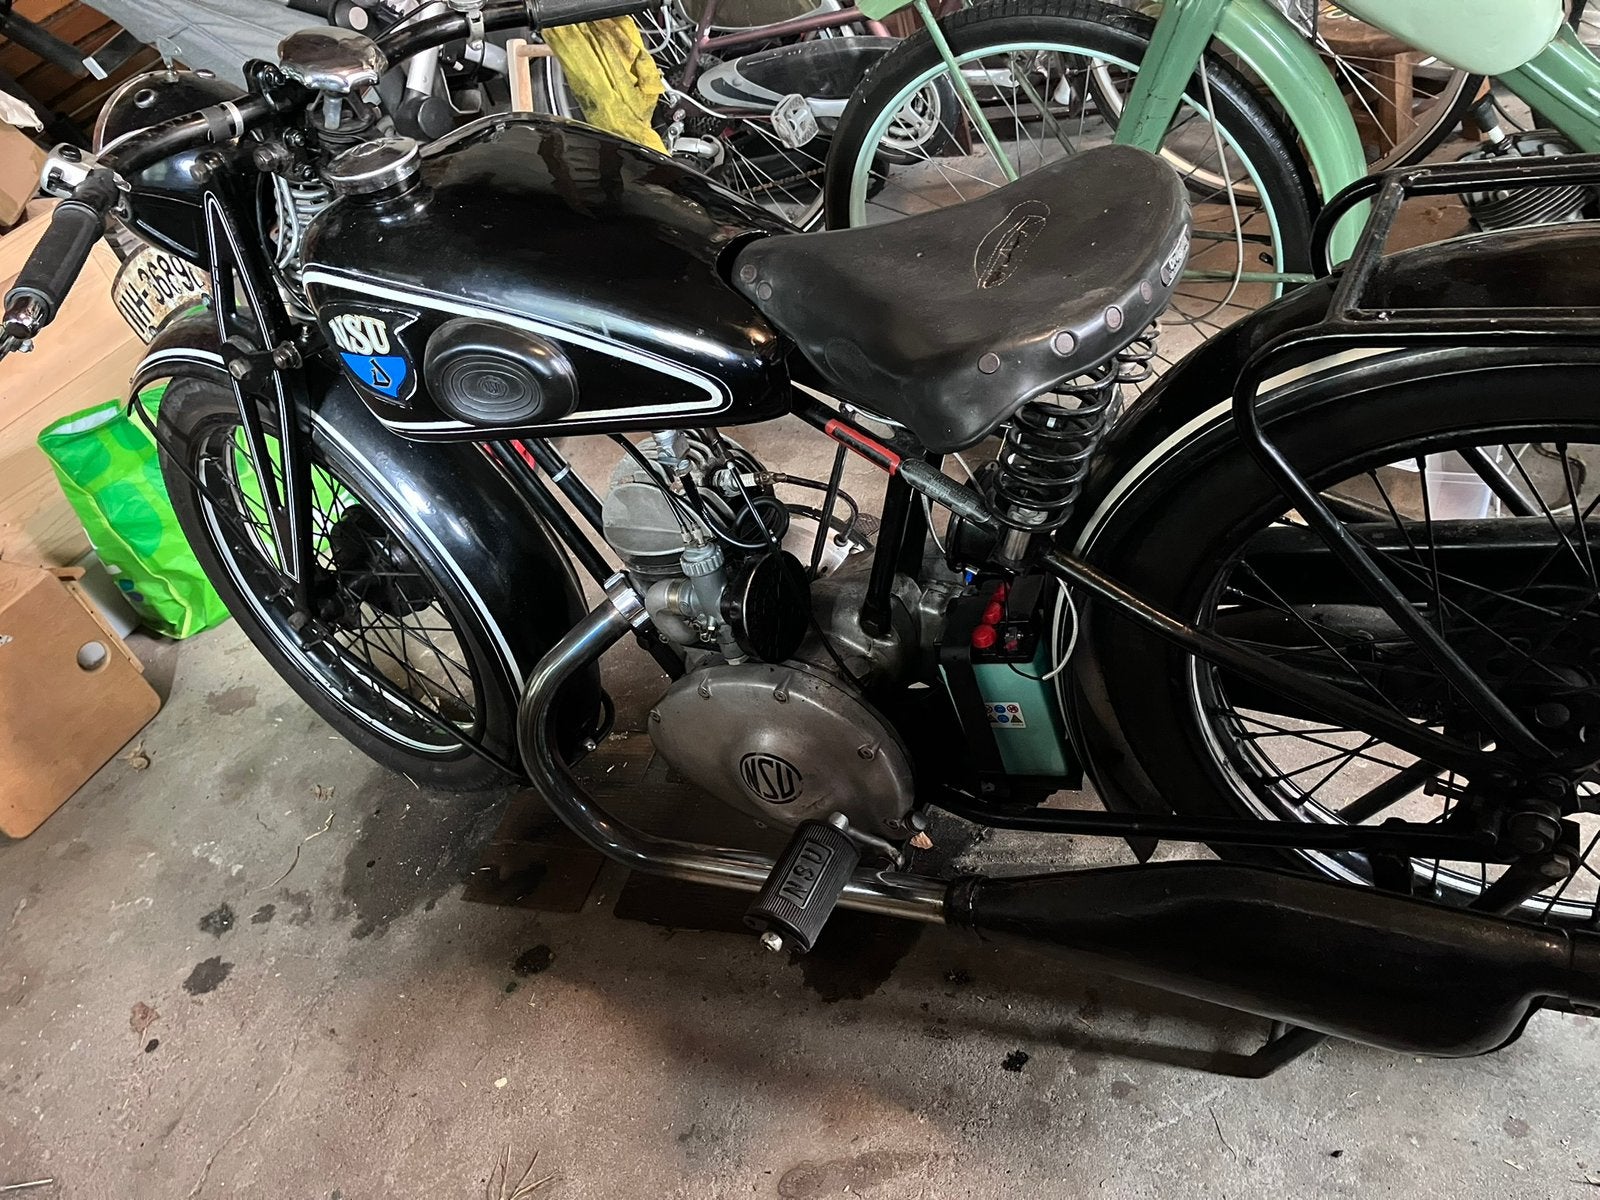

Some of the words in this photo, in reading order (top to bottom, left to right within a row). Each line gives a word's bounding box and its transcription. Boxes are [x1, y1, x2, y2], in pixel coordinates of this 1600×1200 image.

[328, 313, 391, 356] NSU
[744, 758, 795, 799] NSU
[783, 848, 823, 899] NSU
